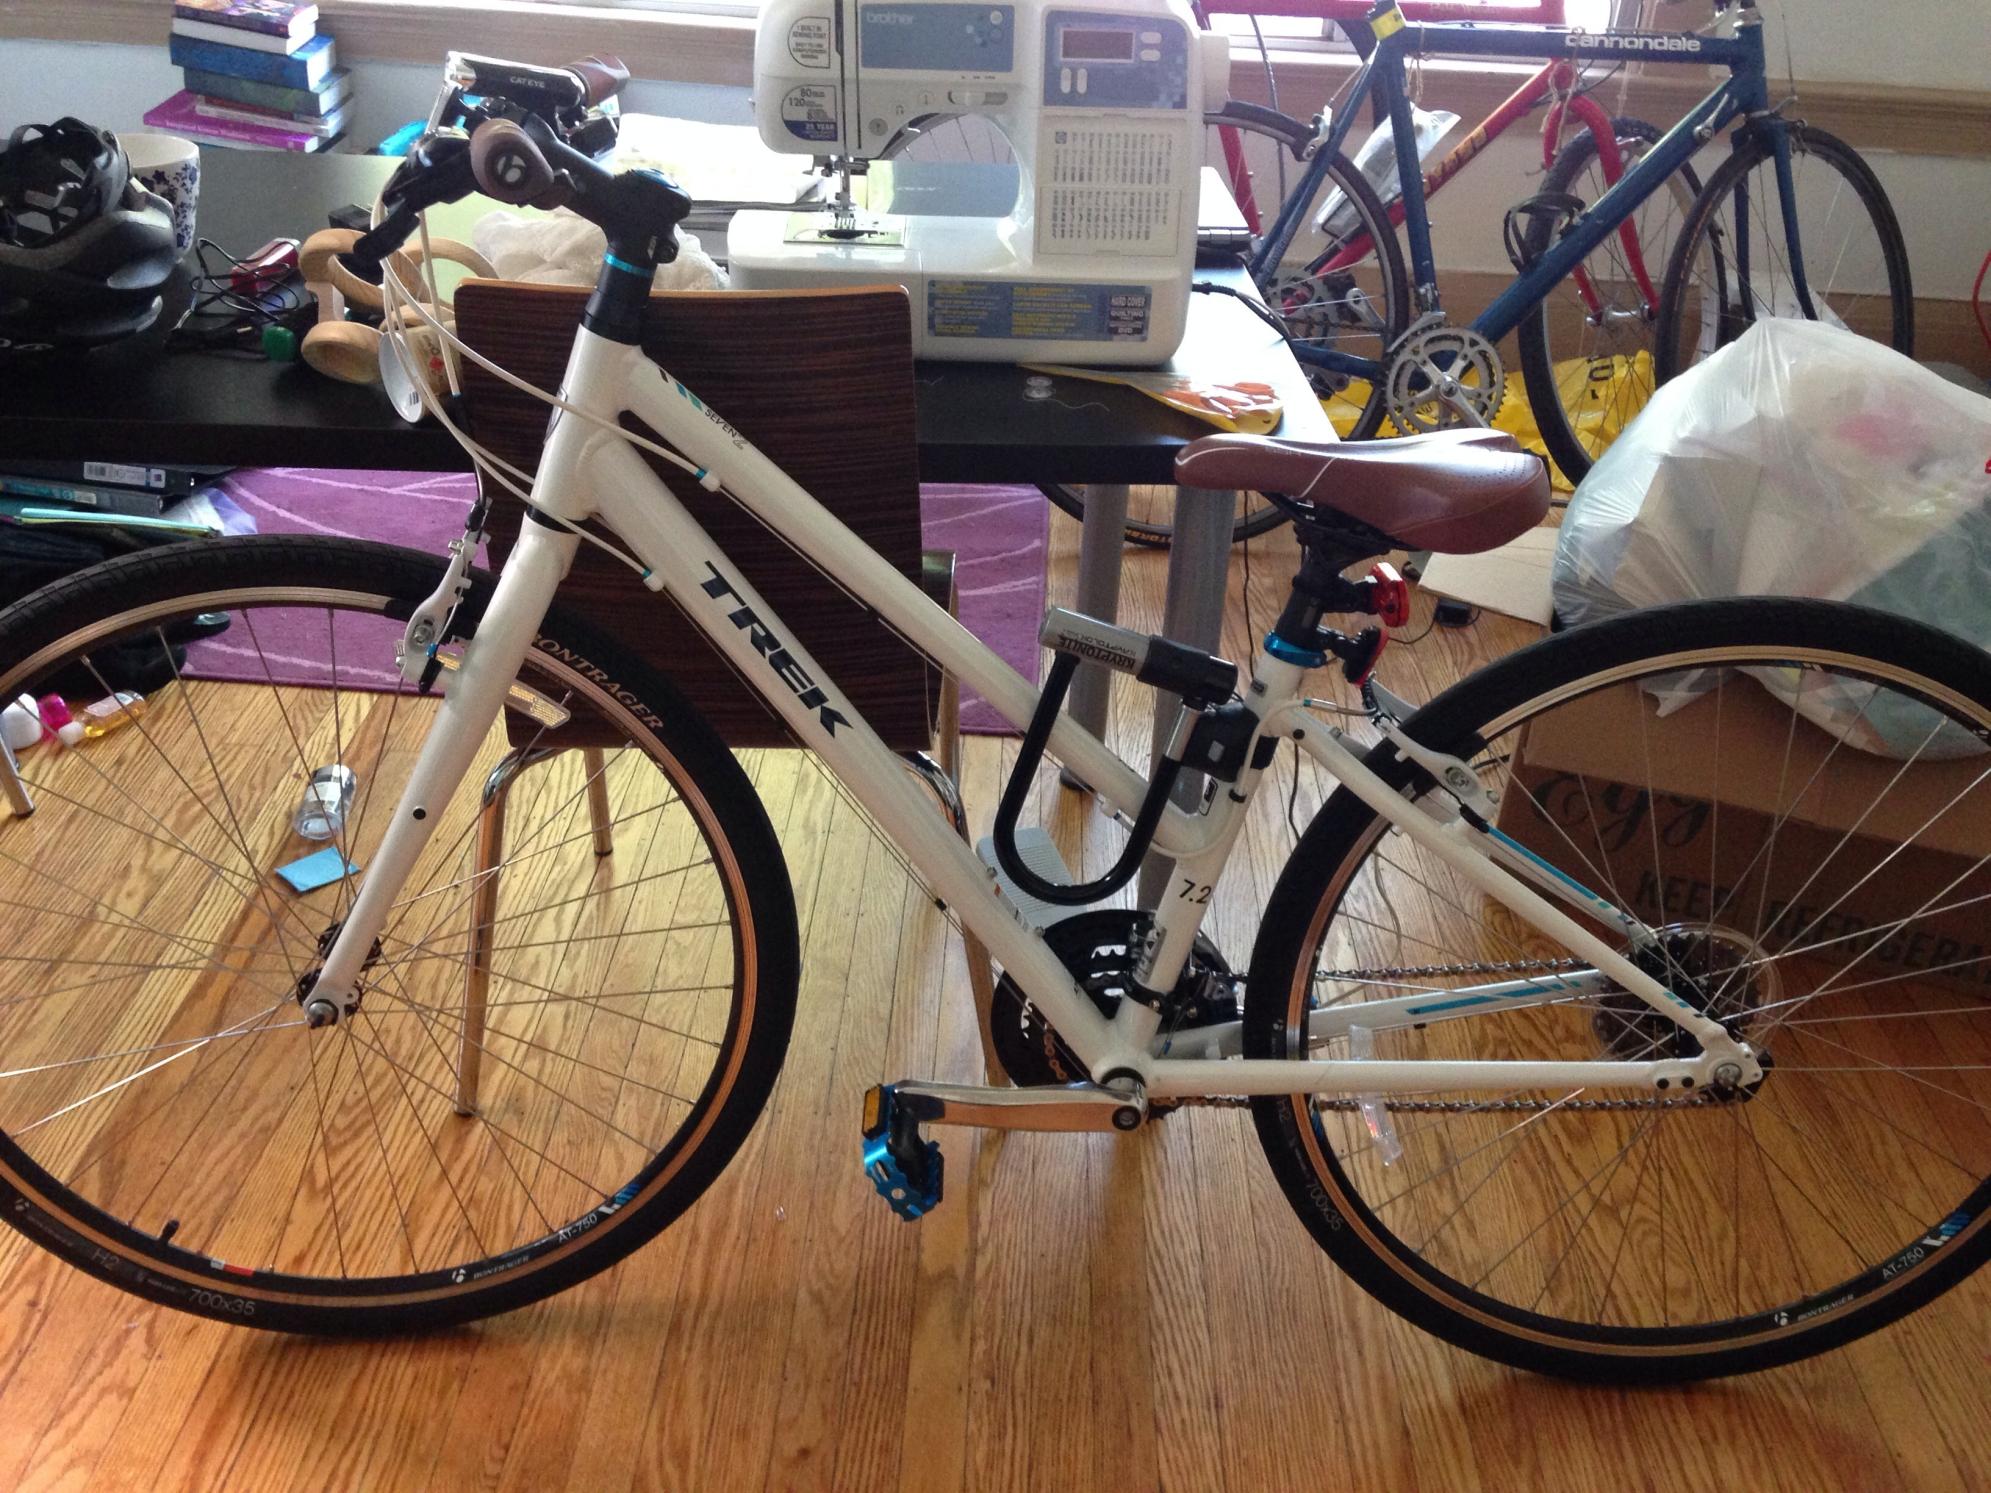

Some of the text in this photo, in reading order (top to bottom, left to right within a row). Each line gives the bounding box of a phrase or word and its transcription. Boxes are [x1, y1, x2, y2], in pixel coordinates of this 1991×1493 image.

[1564, 33, 1701, 52] cannondale
[789, 97, 805, 107] 120
[704, 409, 738, 438] SEVEN
[700, 560, 854, 739] TREK
[1056, 633, 1137, 670] KRYPTONITE
[1179, 878, 1212, 904] 7.2
[1634, 869, 1735, 919] KEEP
[556, 1213, 598, 1244] AT-750
[91, 1251, 121, 1270] H2
[1881, 1246, 1924, 1280] AT-750
[188, 1288, 256, 1317] 700x35
